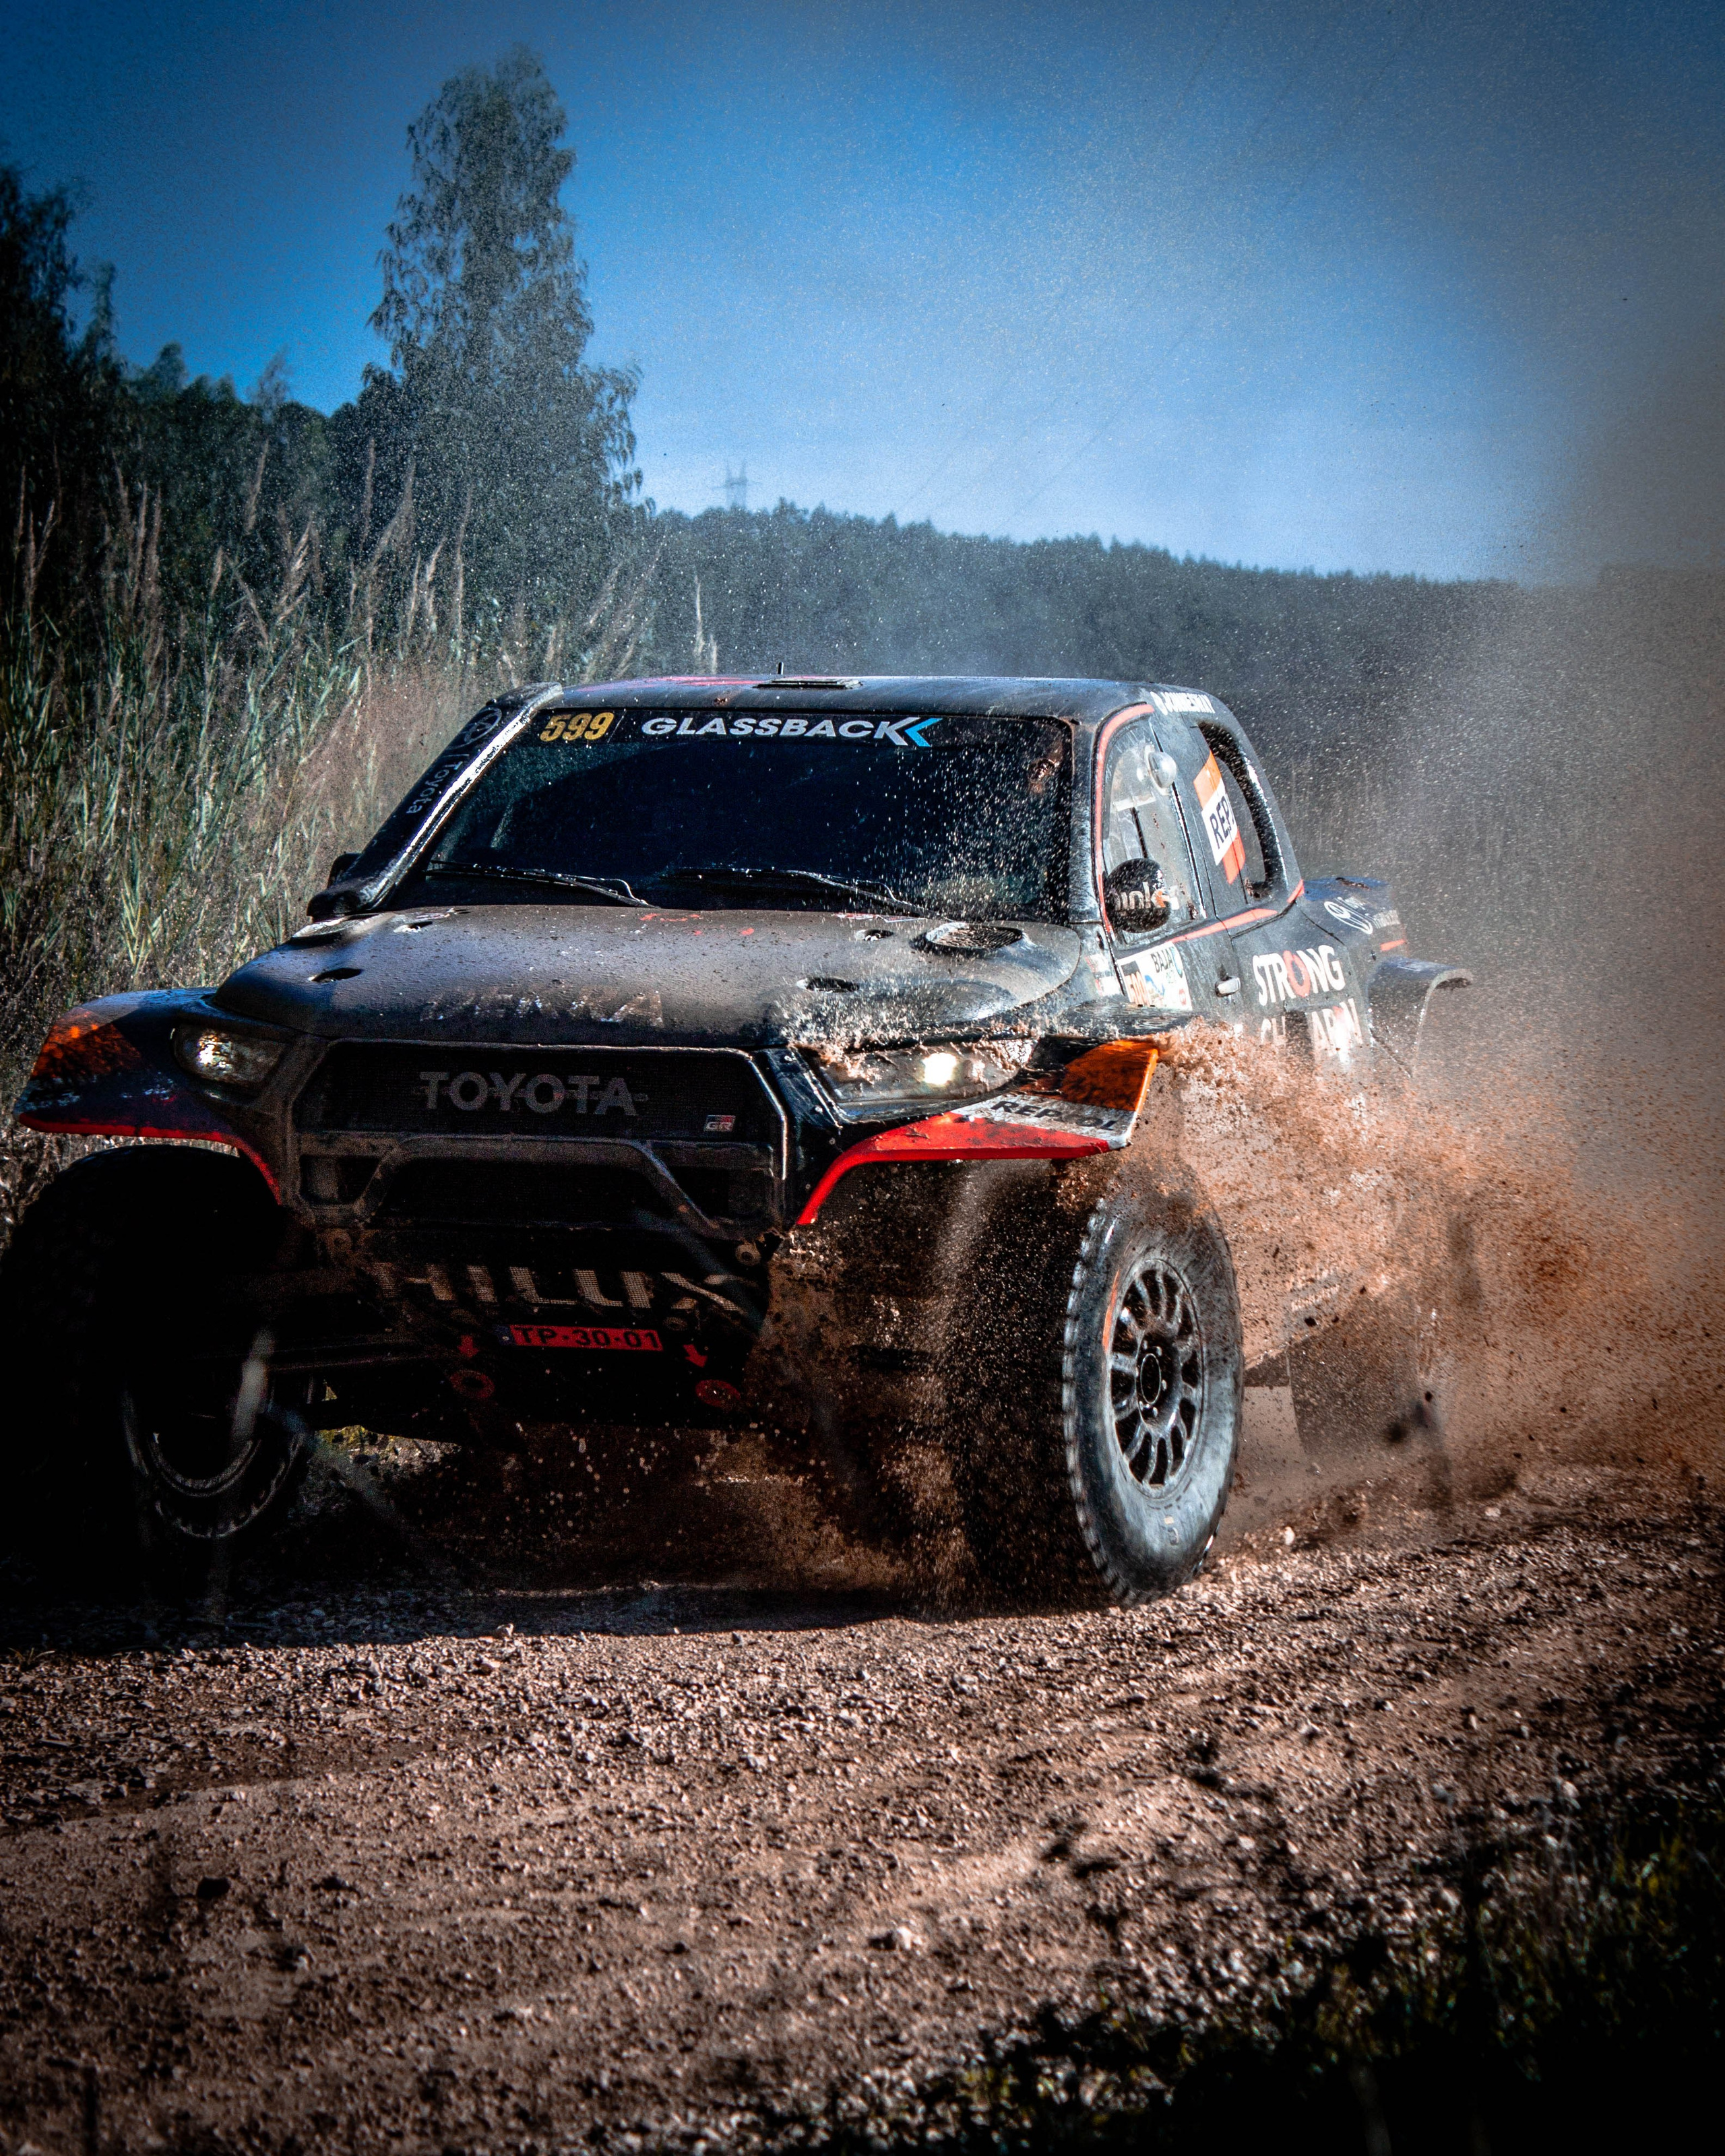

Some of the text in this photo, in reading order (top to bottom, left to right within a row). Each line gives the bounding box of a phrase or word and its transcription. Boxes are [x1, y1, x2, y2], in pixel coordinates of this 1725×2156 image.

[540, 712, 615, 742] 599
[641, 716, 921, 746] GLASSBACK
[406, 761, 464, 815] Toyota
[1210, 796, 1234, 850] REP
[1150, 948, 1174, 974] BAJA
[1252, 945, 1346, 1007] STRONG
[418, 1071, 637, 1116] TOYOTA
[705, 1120, 734, 1133] GR
[990, 1100, 1119, 1131] REPOL
[513, 1327, 660, 1349] TP-30-01
